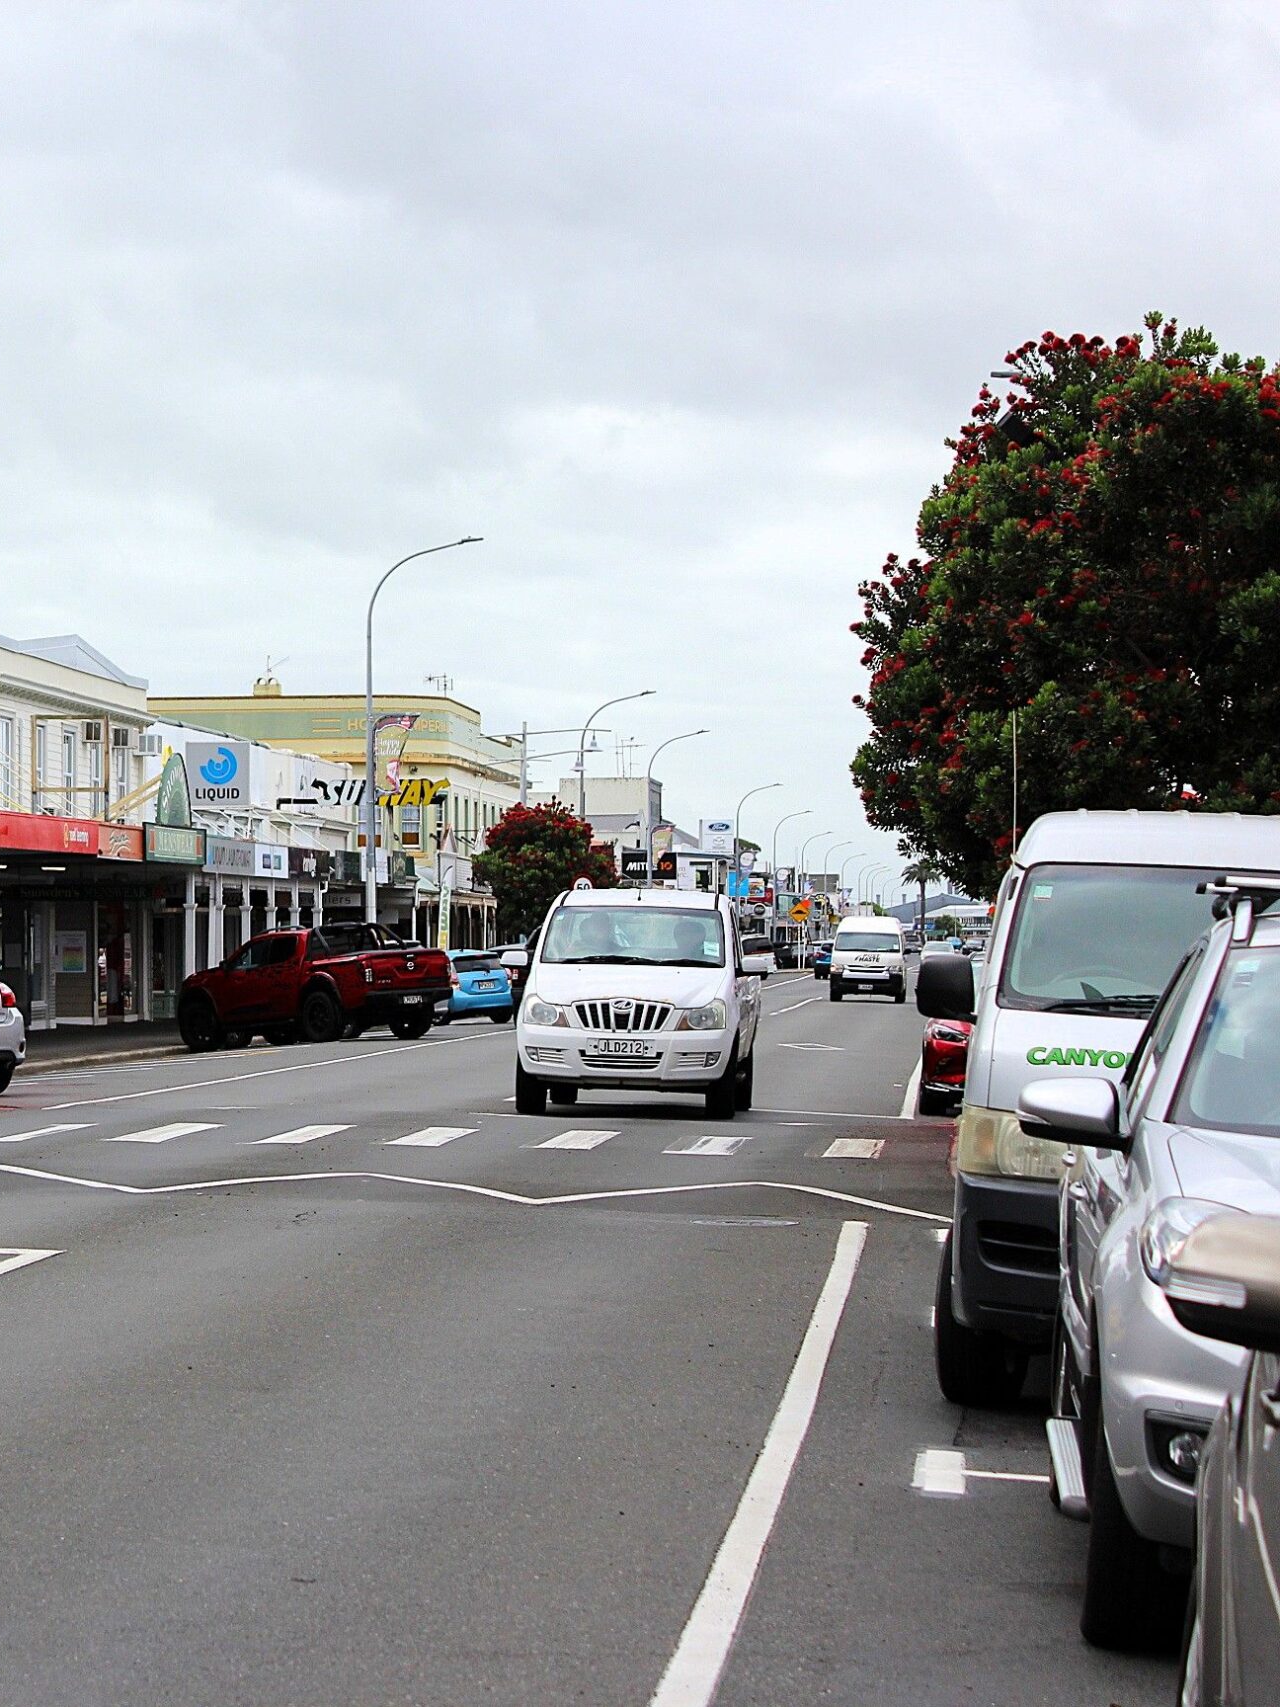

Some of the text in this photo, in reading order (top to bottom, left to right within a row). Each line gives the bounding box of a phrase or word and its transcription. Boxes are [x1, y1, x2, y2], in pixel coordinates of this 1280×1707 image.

[195, 788, 240, 801] LIQUID
[313, 778, 449, 806] SUWAY
[660, 862, 673, 871] 10
[599, 1041, 643, 1054] JLD212
